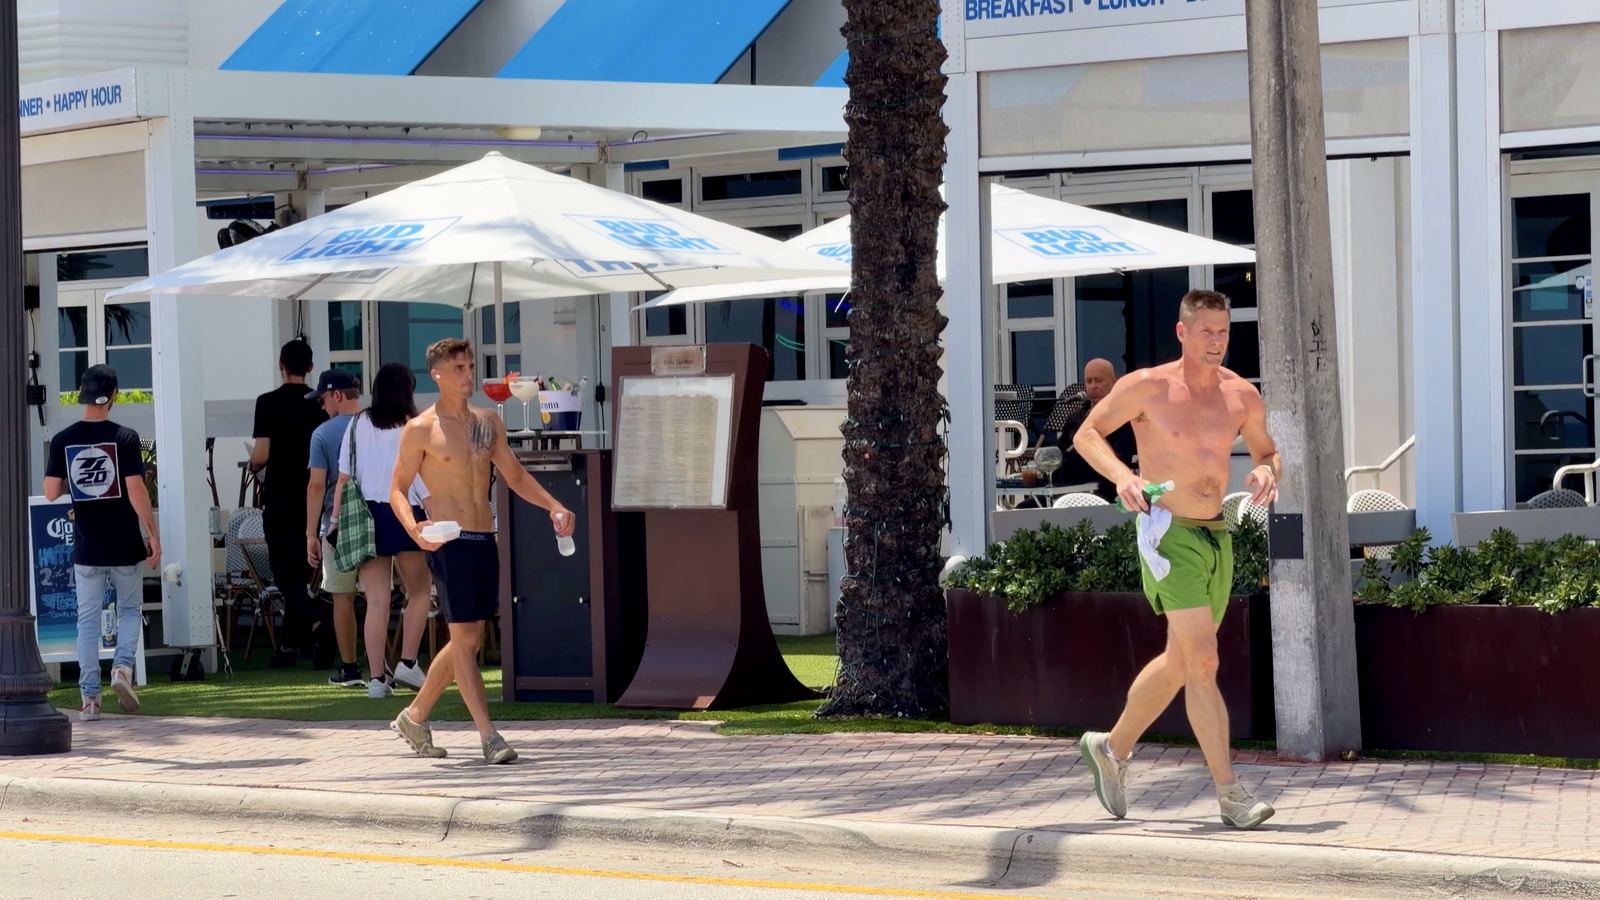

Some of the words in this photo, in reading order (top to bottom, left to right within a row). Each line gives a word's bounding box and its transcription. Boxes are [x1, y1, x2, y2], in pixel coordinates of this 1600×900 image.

[17, 97, 43, 118] NNER
[54, 89, 88, 112] HAPPY
[91, 85, 122, 107] HOUR
[327, 223, 425, 244] BUD
[594, 219, 680, 234] BUD
[607, 232, 720, 250] LIGHT
[1022, 230, 1102, 244] BUD
[287, 238, 424, 260] LIGHT
[817, 244, 851, 257] BU
[1032, 241, 1137, 255] LIGHT
[76, 471, 107, 484] 20
